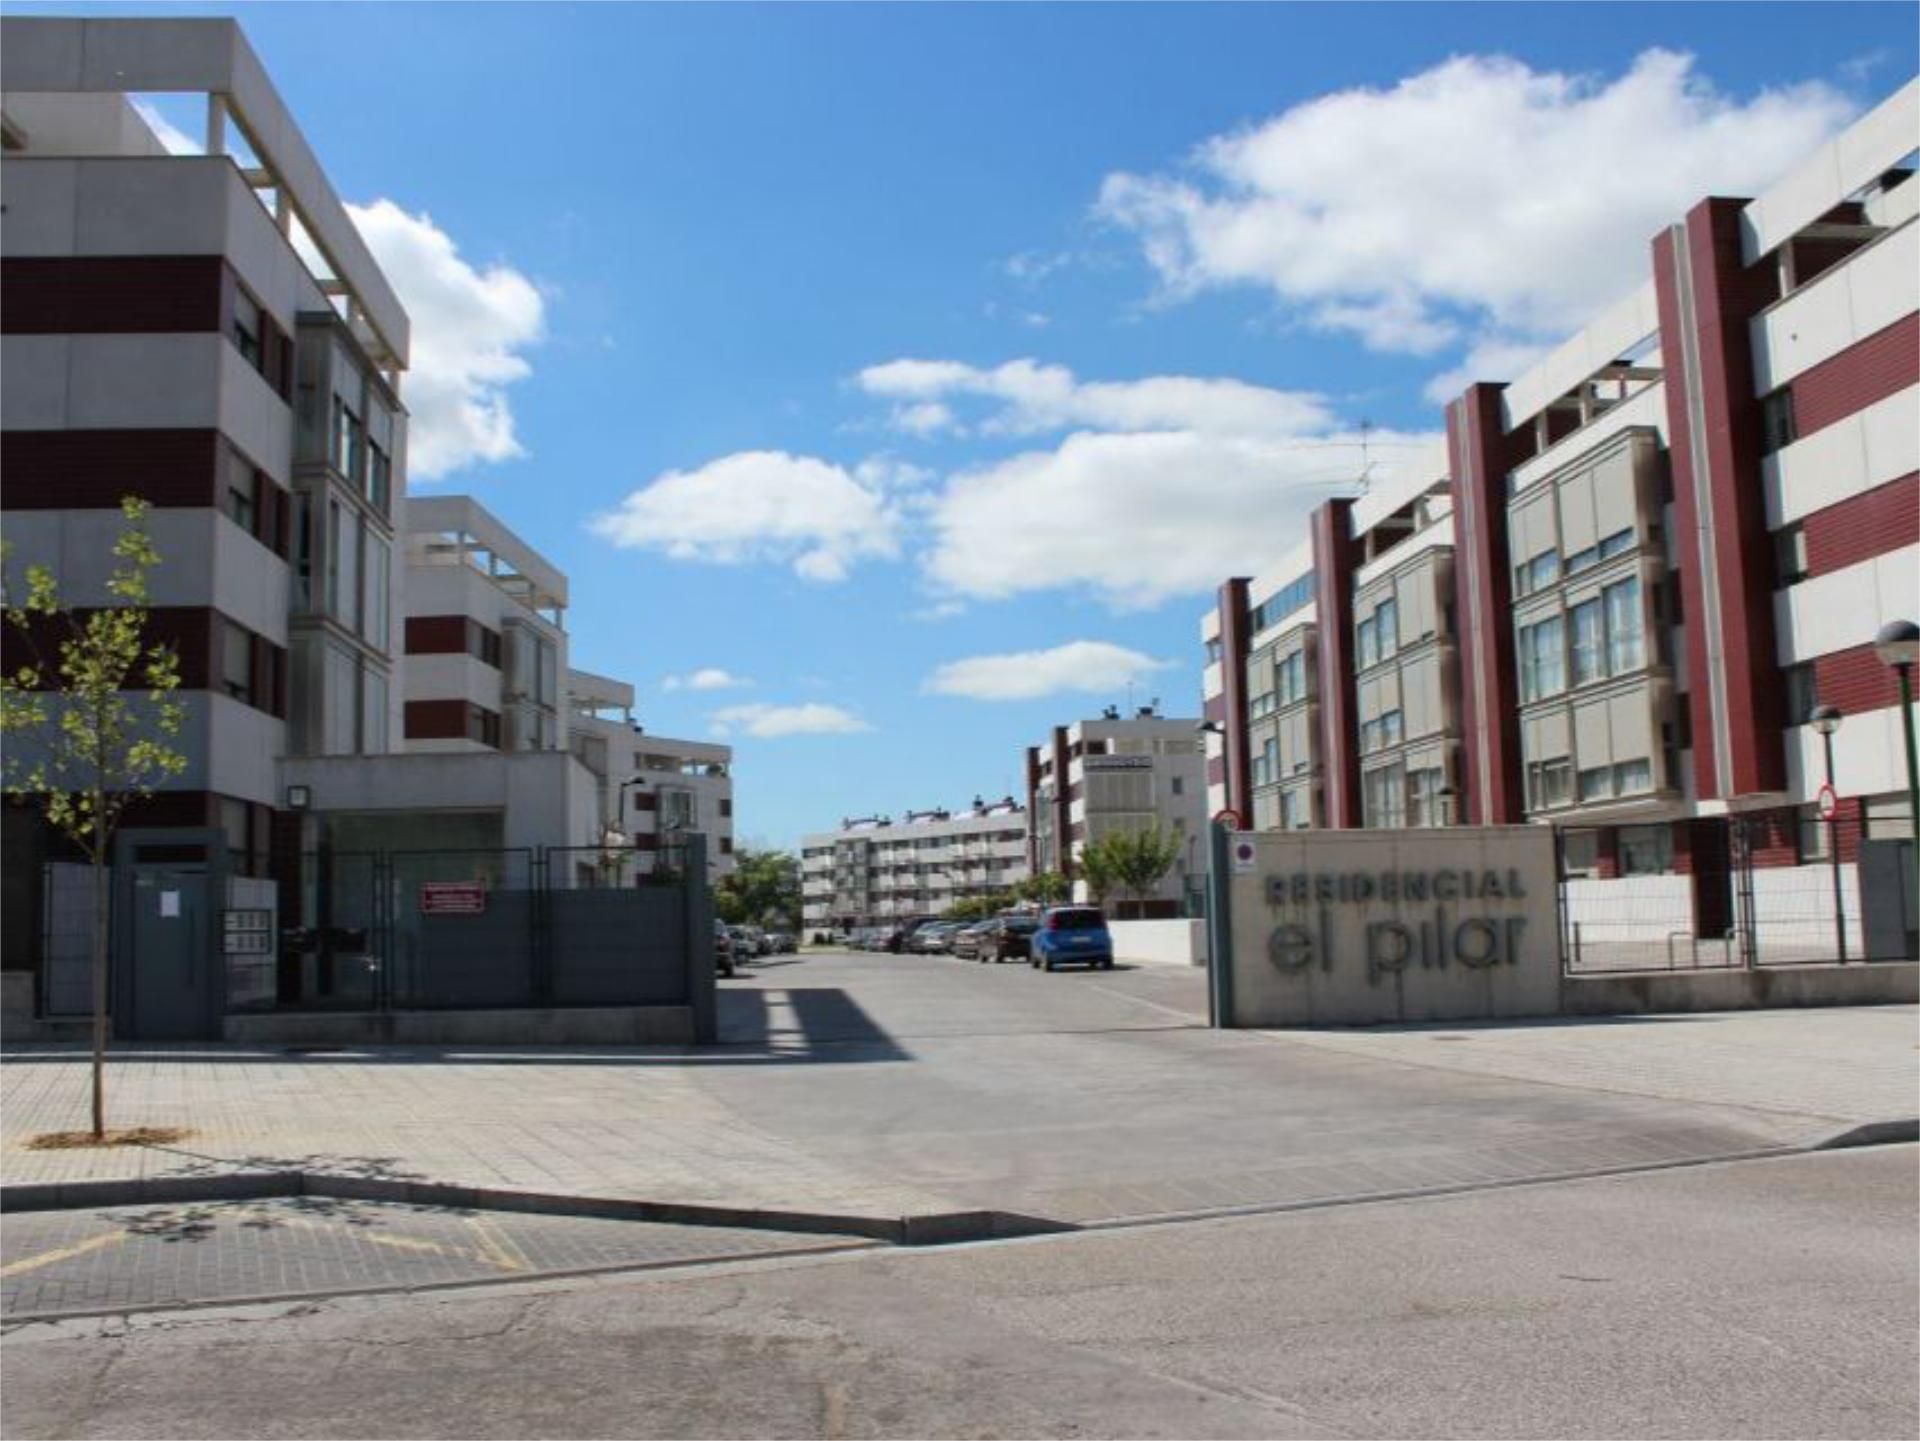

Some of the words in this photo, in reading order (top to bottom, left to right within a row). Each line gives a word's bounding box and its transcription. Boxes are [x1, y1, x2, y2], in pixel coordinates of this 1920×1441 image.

[1265, 867, 1527, 904] RESIDENCIAL
[1269, 908, 1331, 974] el
[1367, 904, 1527, 986] pilar
